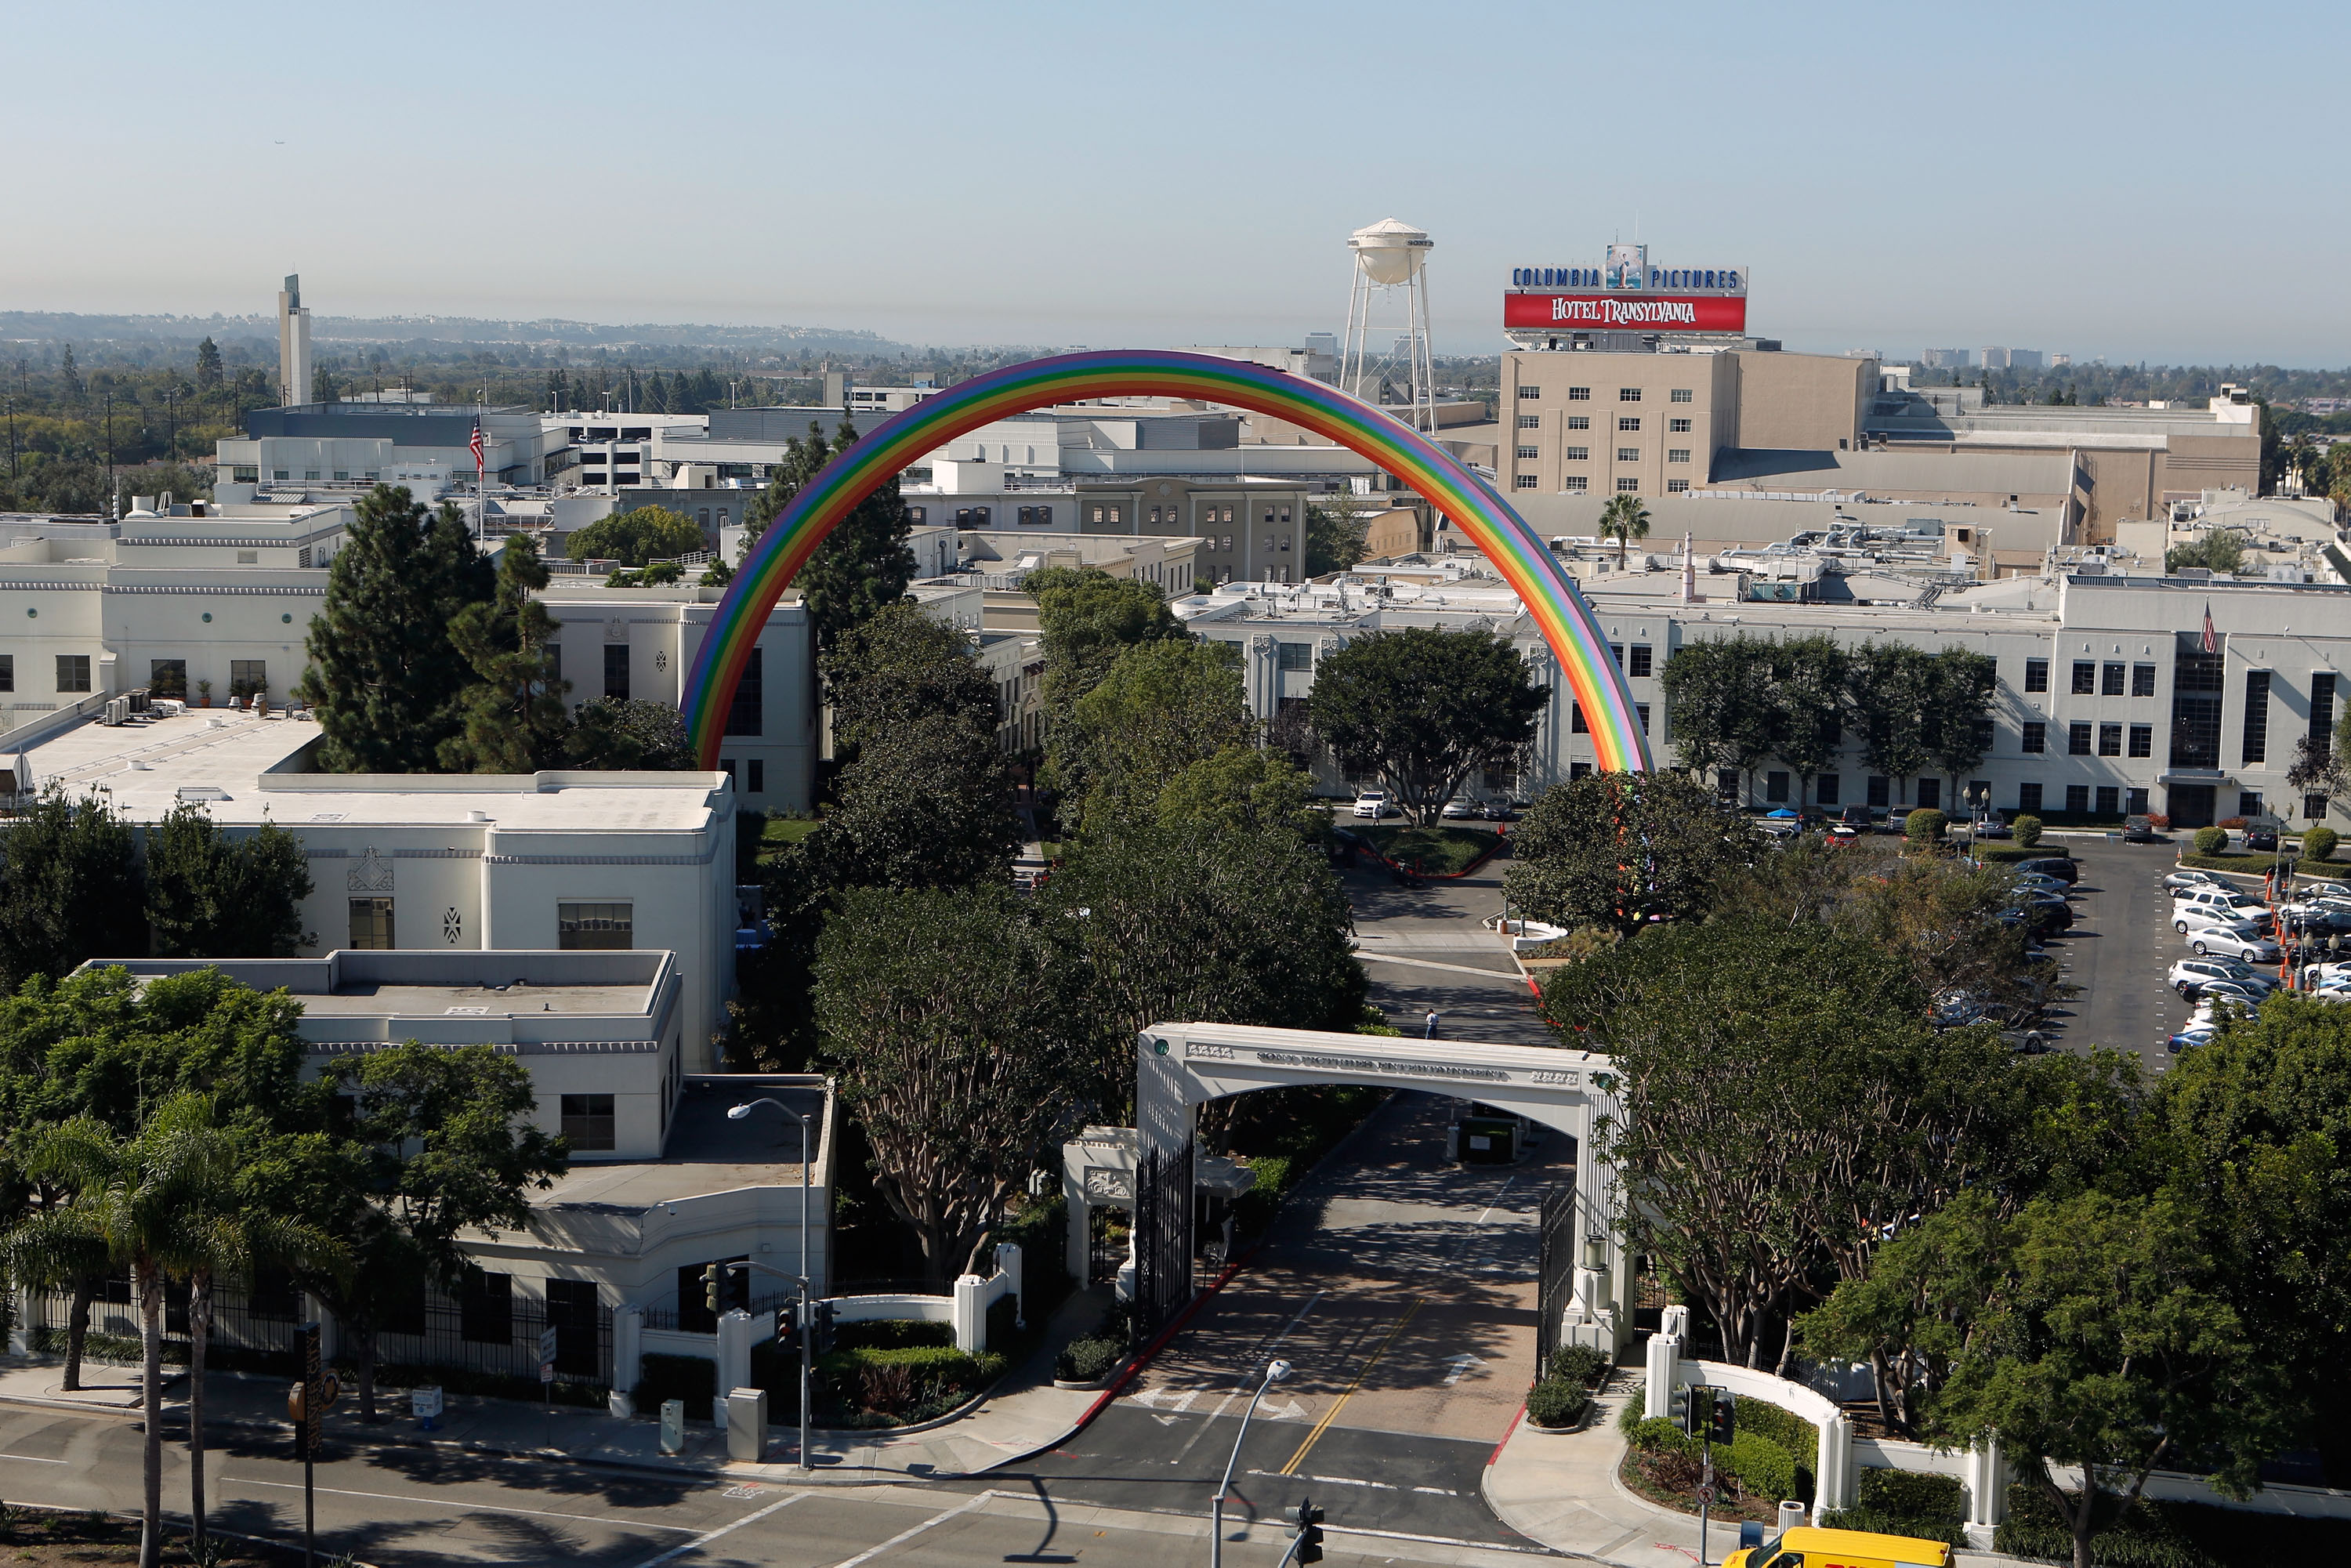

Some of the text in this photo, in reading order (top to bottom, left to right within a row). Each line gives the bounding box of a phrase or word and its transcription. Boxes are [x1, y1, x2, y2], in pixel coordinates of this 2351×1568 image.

[1512, 267, 1737, 288] COLUMBIA PICTURES
[1552, 297, 1697, 324] HOTEL TRANSYLVANIA
[2128, 505, 2141, 513] 25
[1257, 1052, 1508, 1078] SONY PICTURES ENTERTAINMENT
[308, 1335, 320, 1449] CULVER CITY
